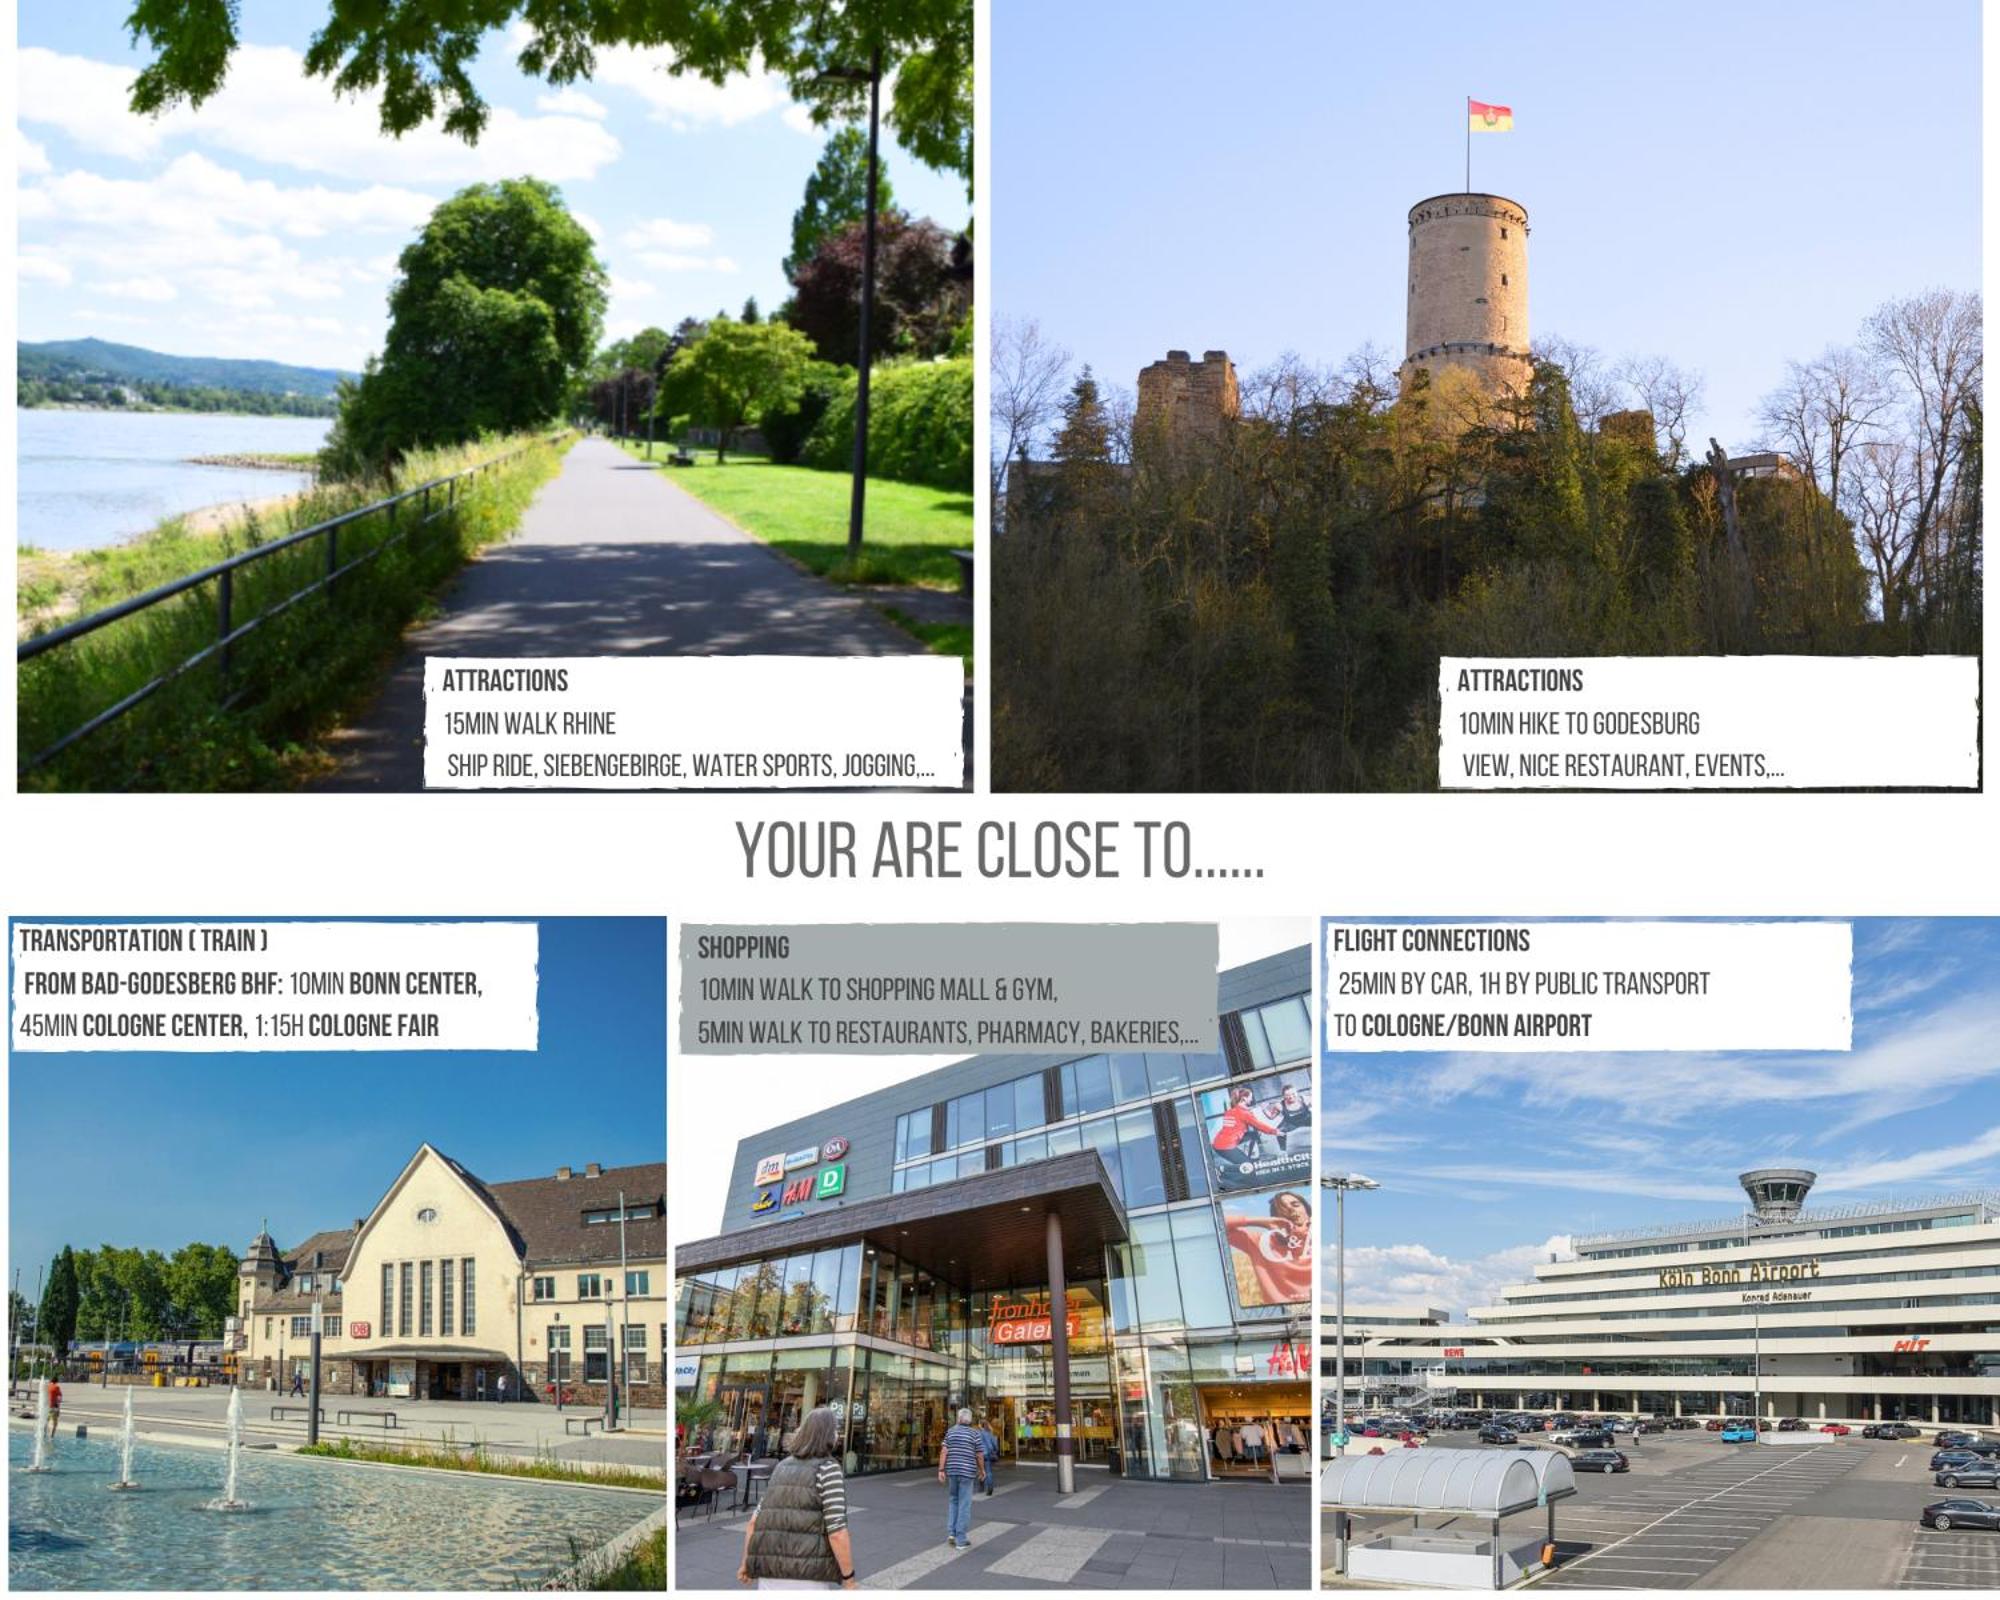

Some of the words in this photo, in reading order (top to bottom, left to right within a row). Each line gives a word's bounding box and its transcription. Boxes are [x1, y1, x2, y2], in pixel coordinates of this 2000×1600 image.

[1253, 1153, 1312, 1169] HealthCit
[1659, 1268, 1694, 1288] Köln
[1702, 1266, 1740, 1285] Bonn
[1750, 1258, 1820, 1283] Airport
[1742, 1292, 1770, 1303] Konrad
[1772, 1291, 1812, 1302] Adenauer
[1894, 1339, 1930, 1355] HIT
